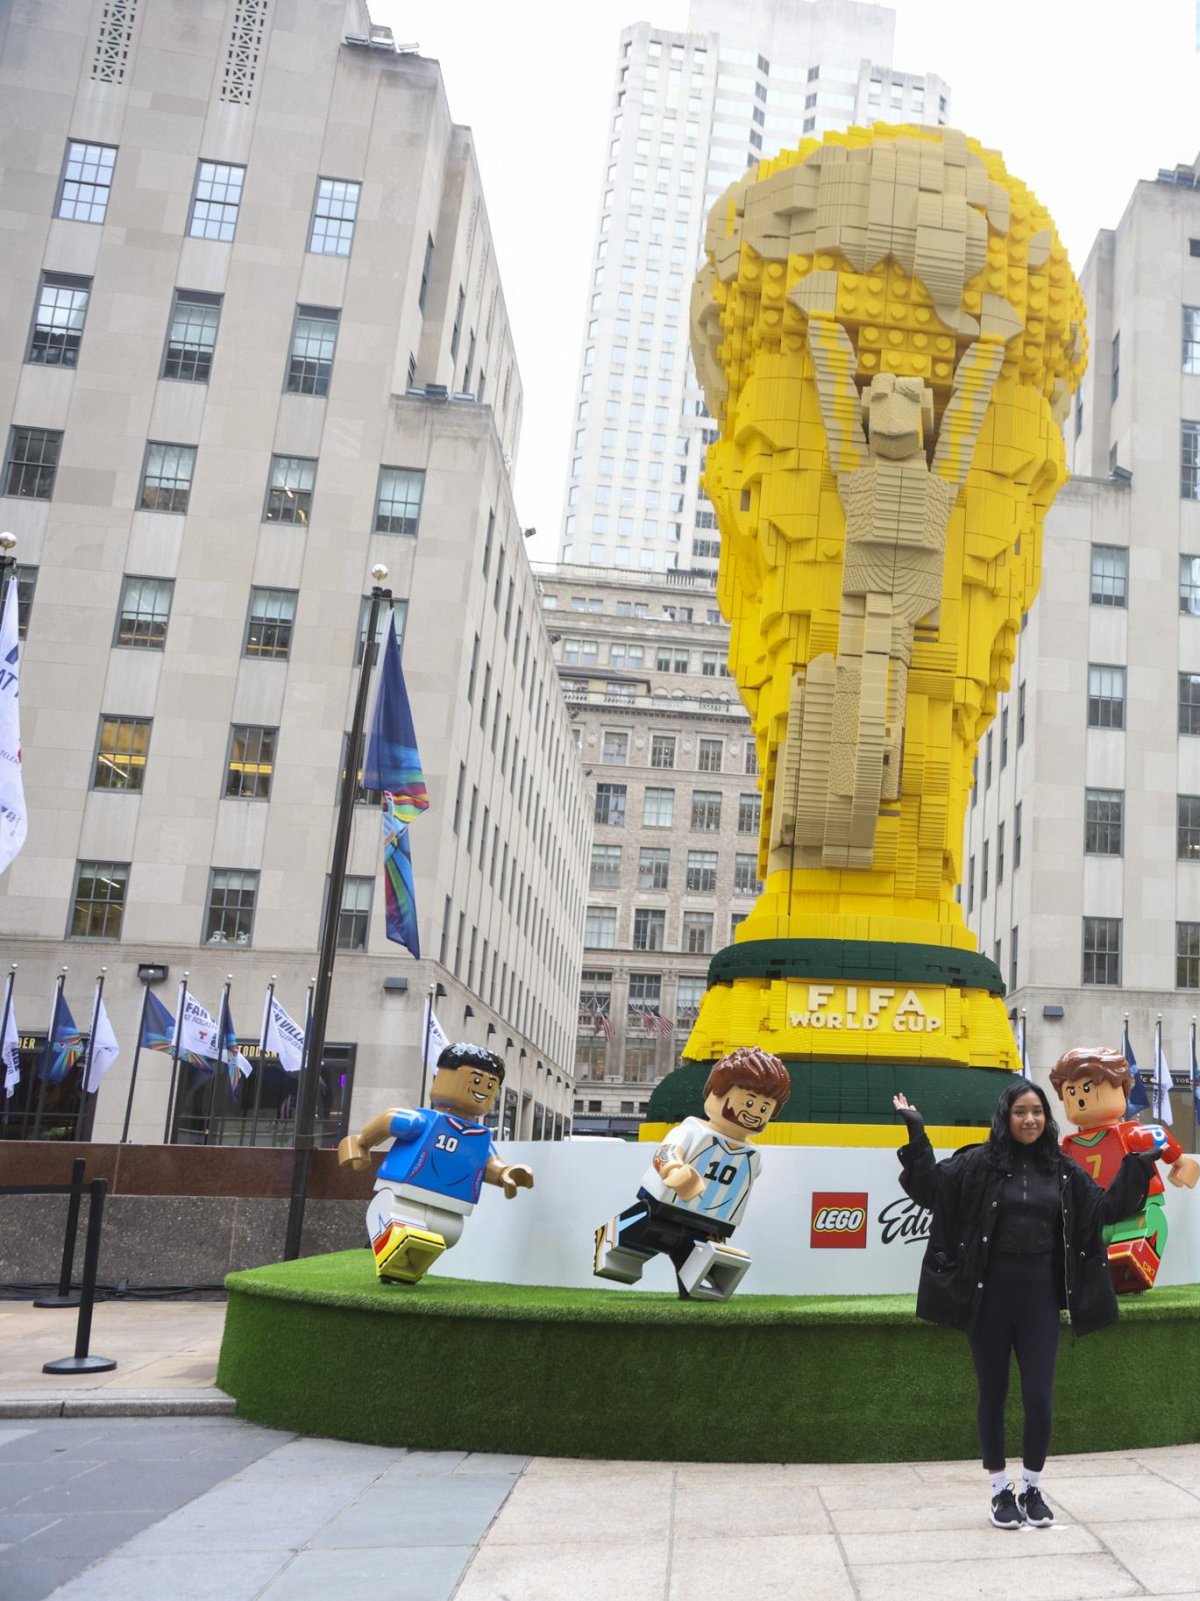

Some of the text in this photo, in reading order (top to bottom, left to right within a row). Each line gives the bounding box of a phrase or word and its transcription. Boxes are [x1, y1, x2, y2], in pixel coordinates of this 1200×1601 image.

[807, 984, 926, 1016] FIFA
[789, 1011, 942, 1032] WORLD CUP
[237, 1046, 260, 1057] TODD
[435, 1134, 459, 1153] 10
[703, 1160, 738, 1186] 10
[1086, 1154, 1102, 1179] 7
[813, 1197, 934, 1245] LEGO Edi
